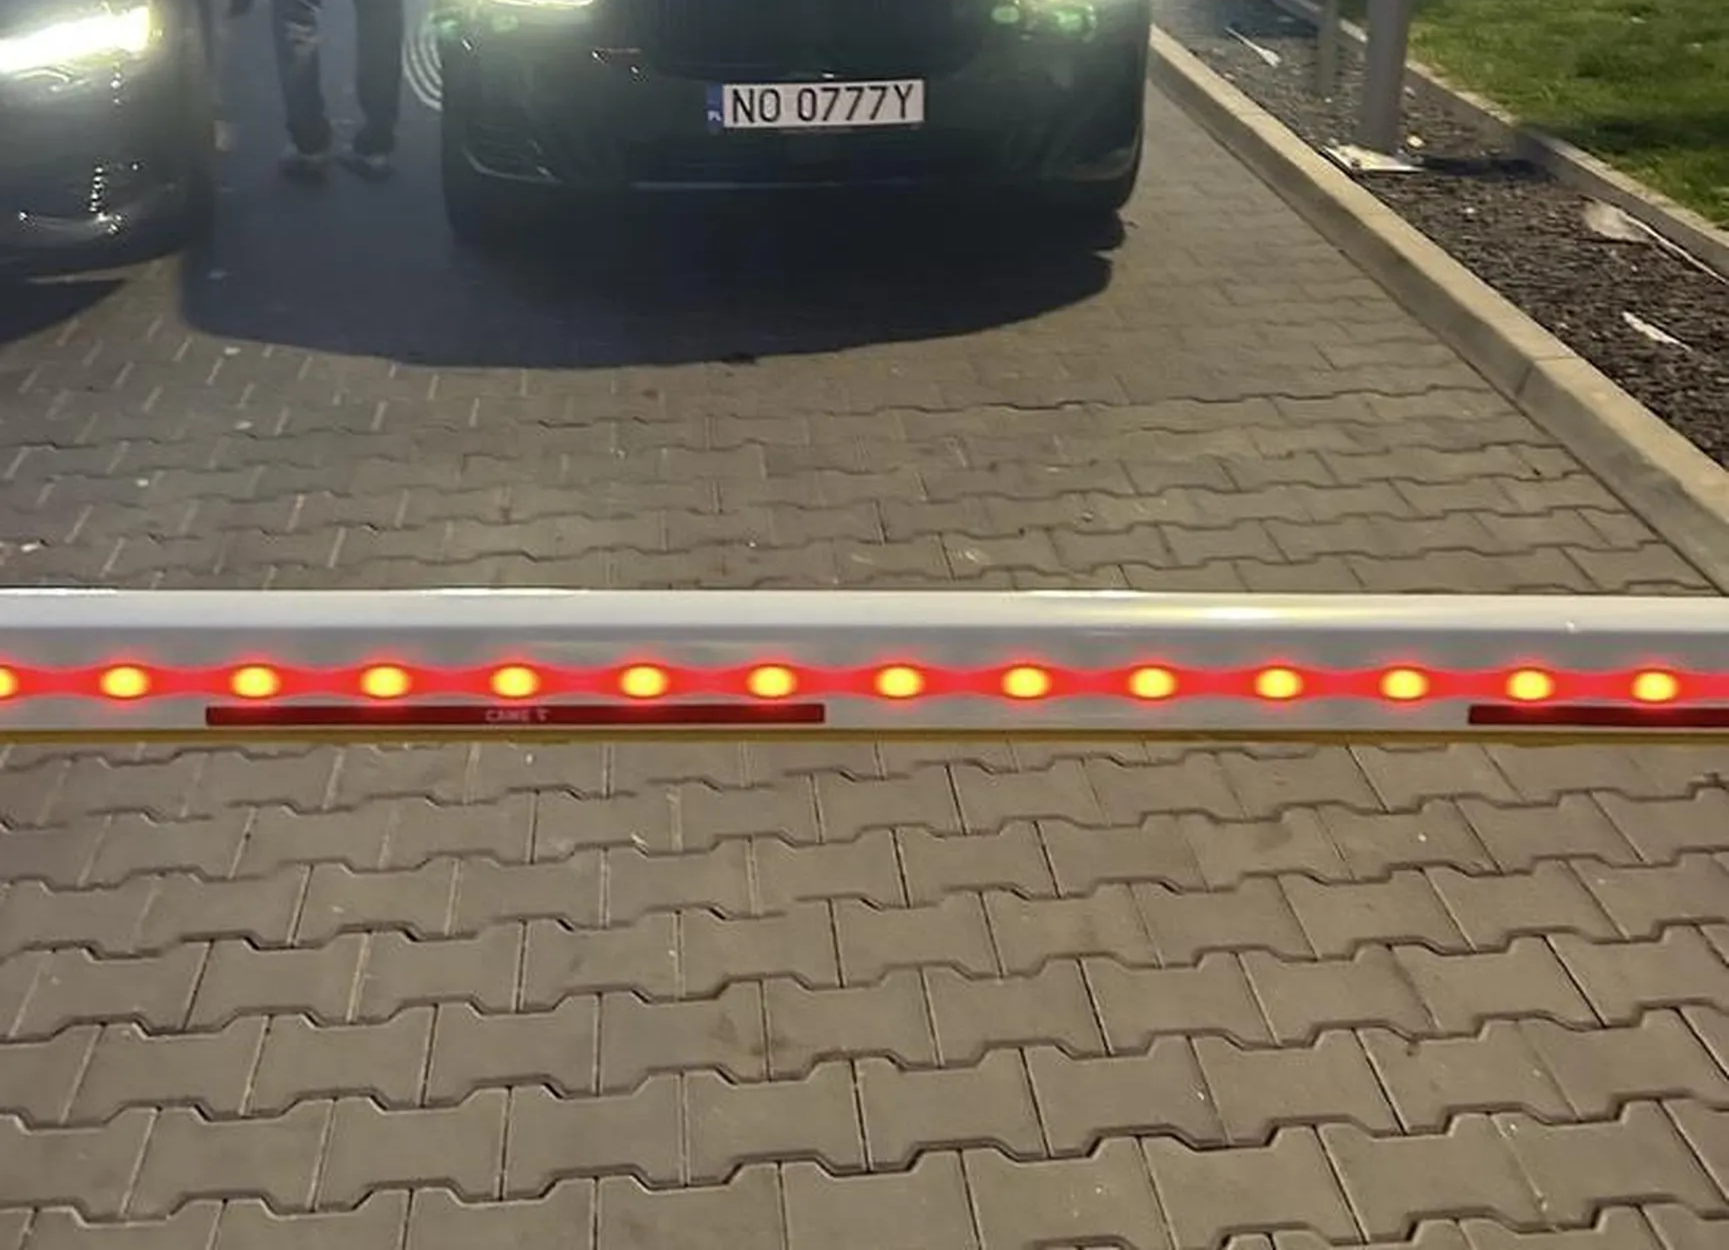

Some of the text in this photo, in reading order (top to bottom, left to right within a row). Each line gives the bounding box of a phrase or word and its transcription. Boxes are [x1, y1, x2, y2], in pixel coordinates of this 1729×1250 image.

[707, 110, 721, 121] PL
[732, 83, 914, 123] NO 0777Y
